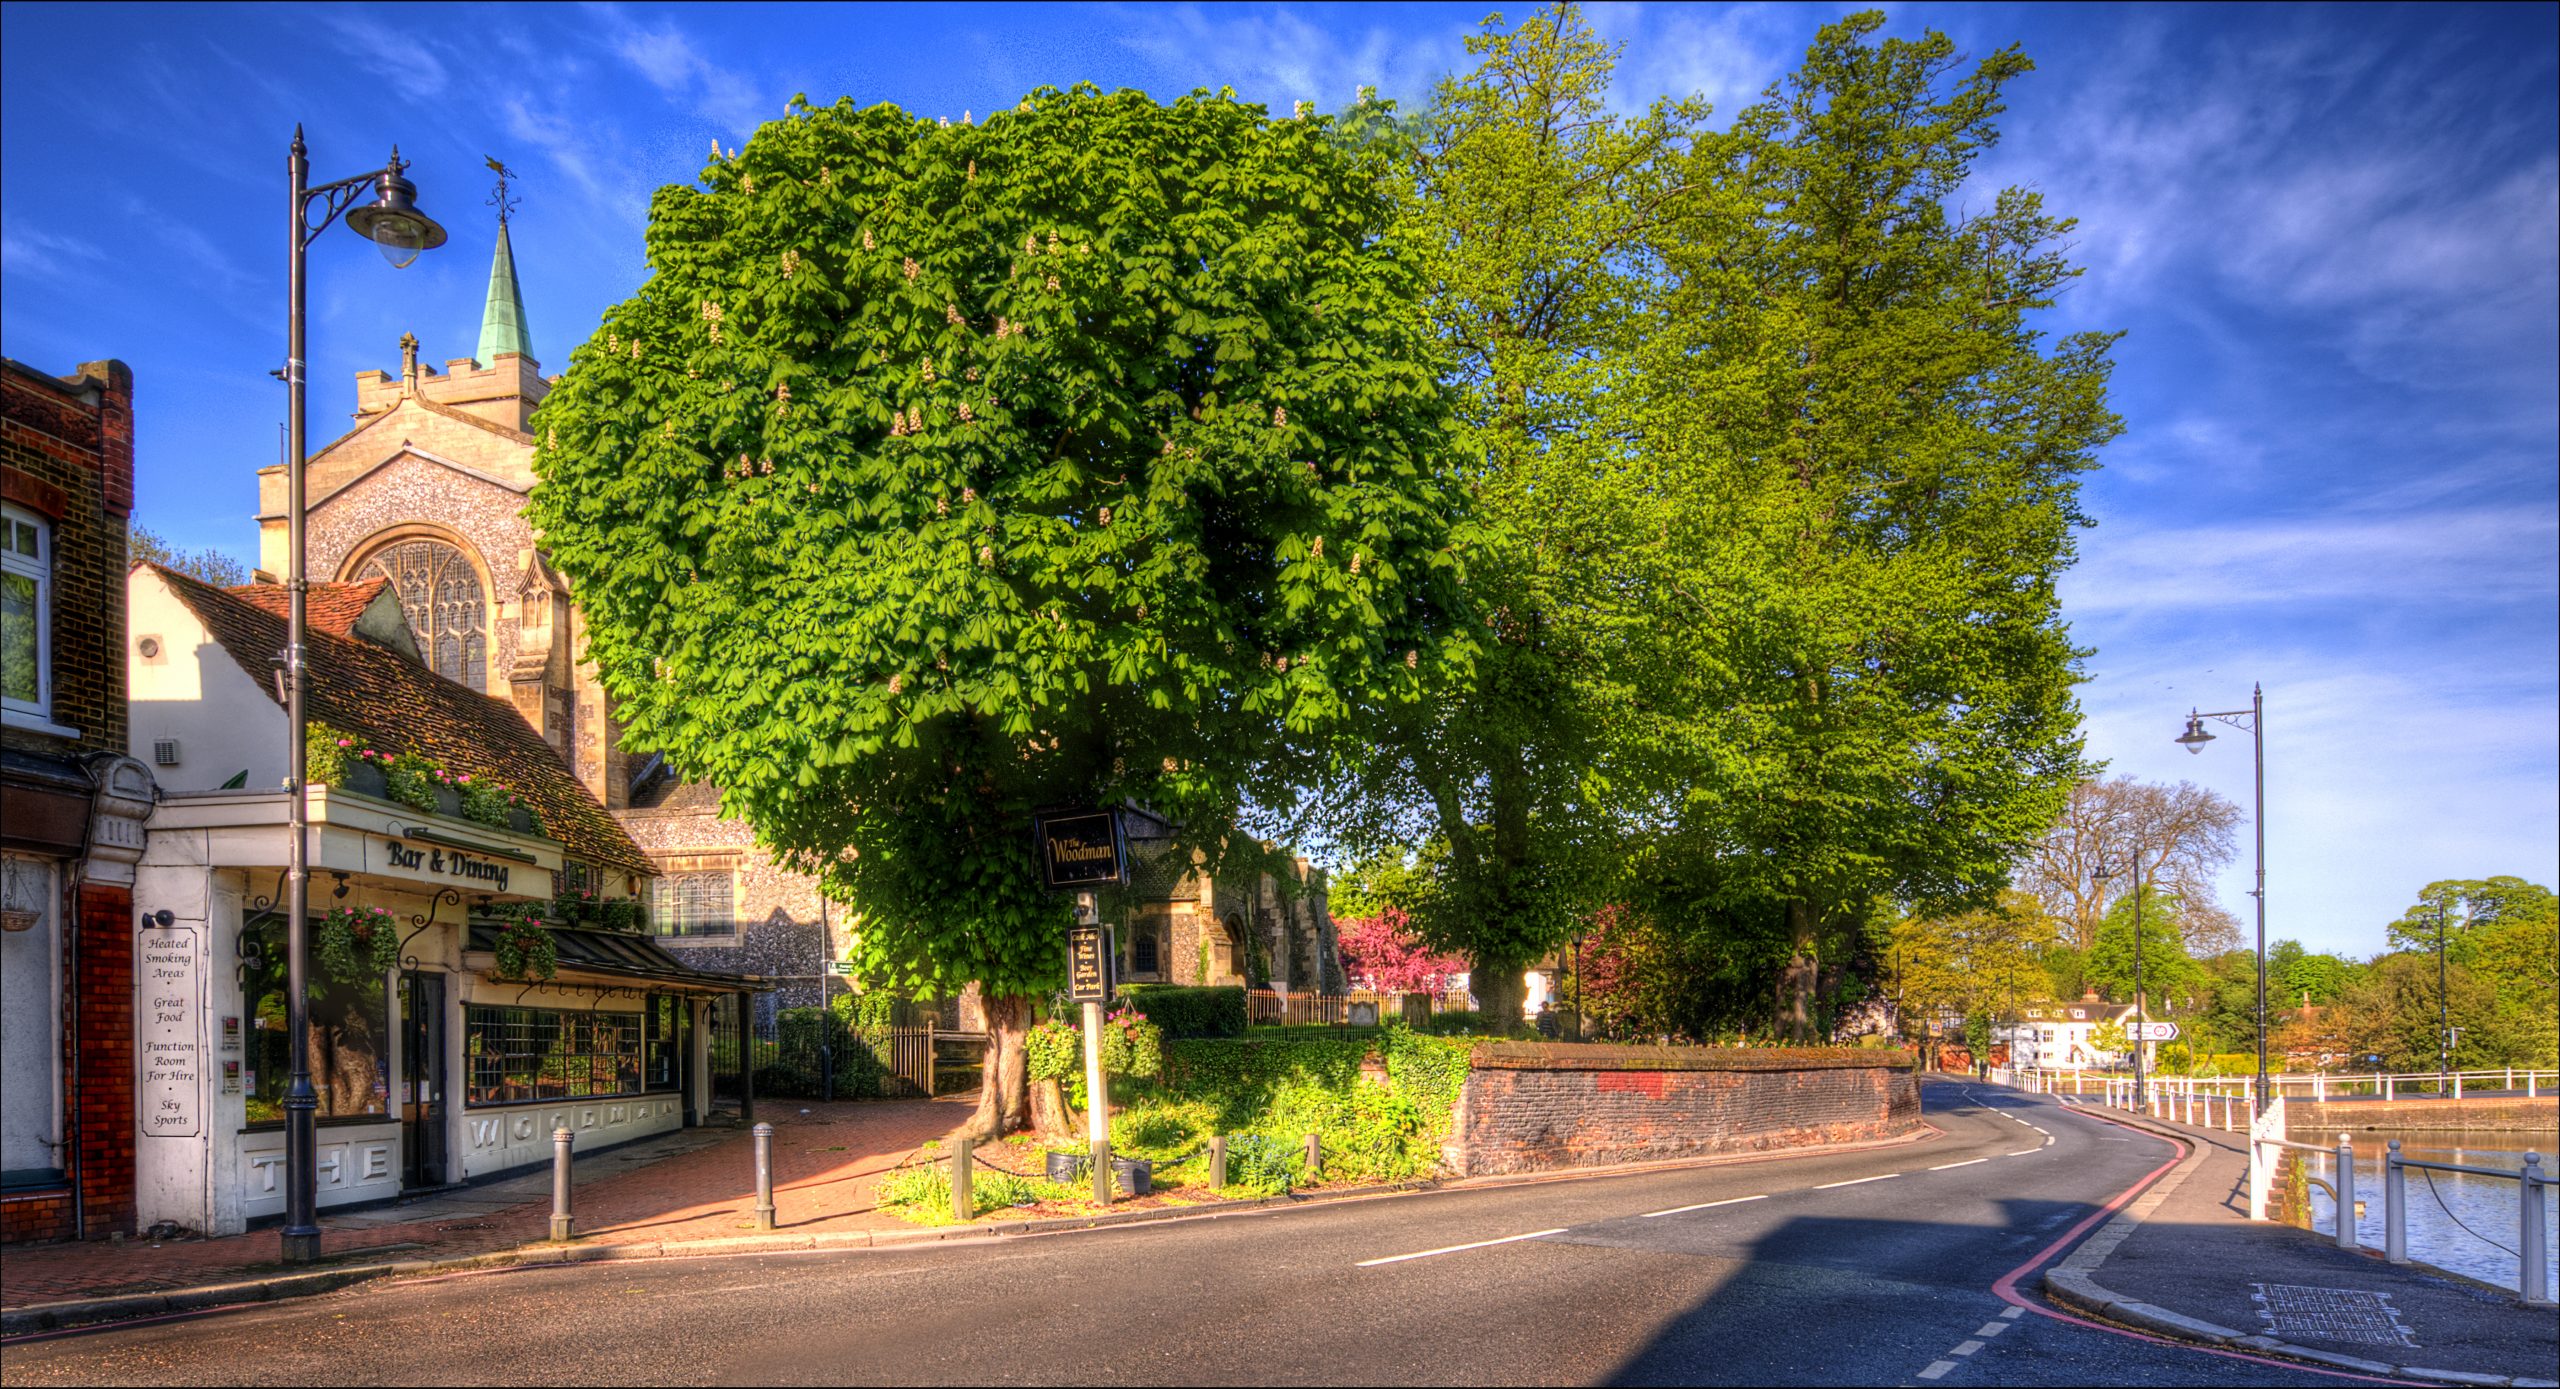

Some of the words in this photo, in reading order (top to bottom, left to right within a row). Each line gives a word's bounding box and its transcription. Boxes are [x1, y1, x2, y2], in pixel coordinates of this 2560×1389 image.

[1069, 837, 1079, 848] The
[1049, 838, 1112, 863] Woodman
[386, 841, 426, 871] Bar
[430, 848, 445, 873] &
[448, 851, 509, 892] Dining
[148, 938, 190, 949] Heated
[145, 952, 192, 967] Smoking
[152, 968, 185, 978] Areas
[1076, 969, 1097, 979] Garden
[1086, 982, 1100, 990] Park
[154, 997, 184, 1009] Great
[155, 1011, 185, 1024] Food
[145, 1041, 194, 1053] Function
[154, 1056, 186, 1066] Room
[145, 1071, 166, 1082] For
[168, 1070, 194, 1081] Hire
[161, 1099, 181, 1113] Sky
[154, 1114, 188, 1128] Sports
